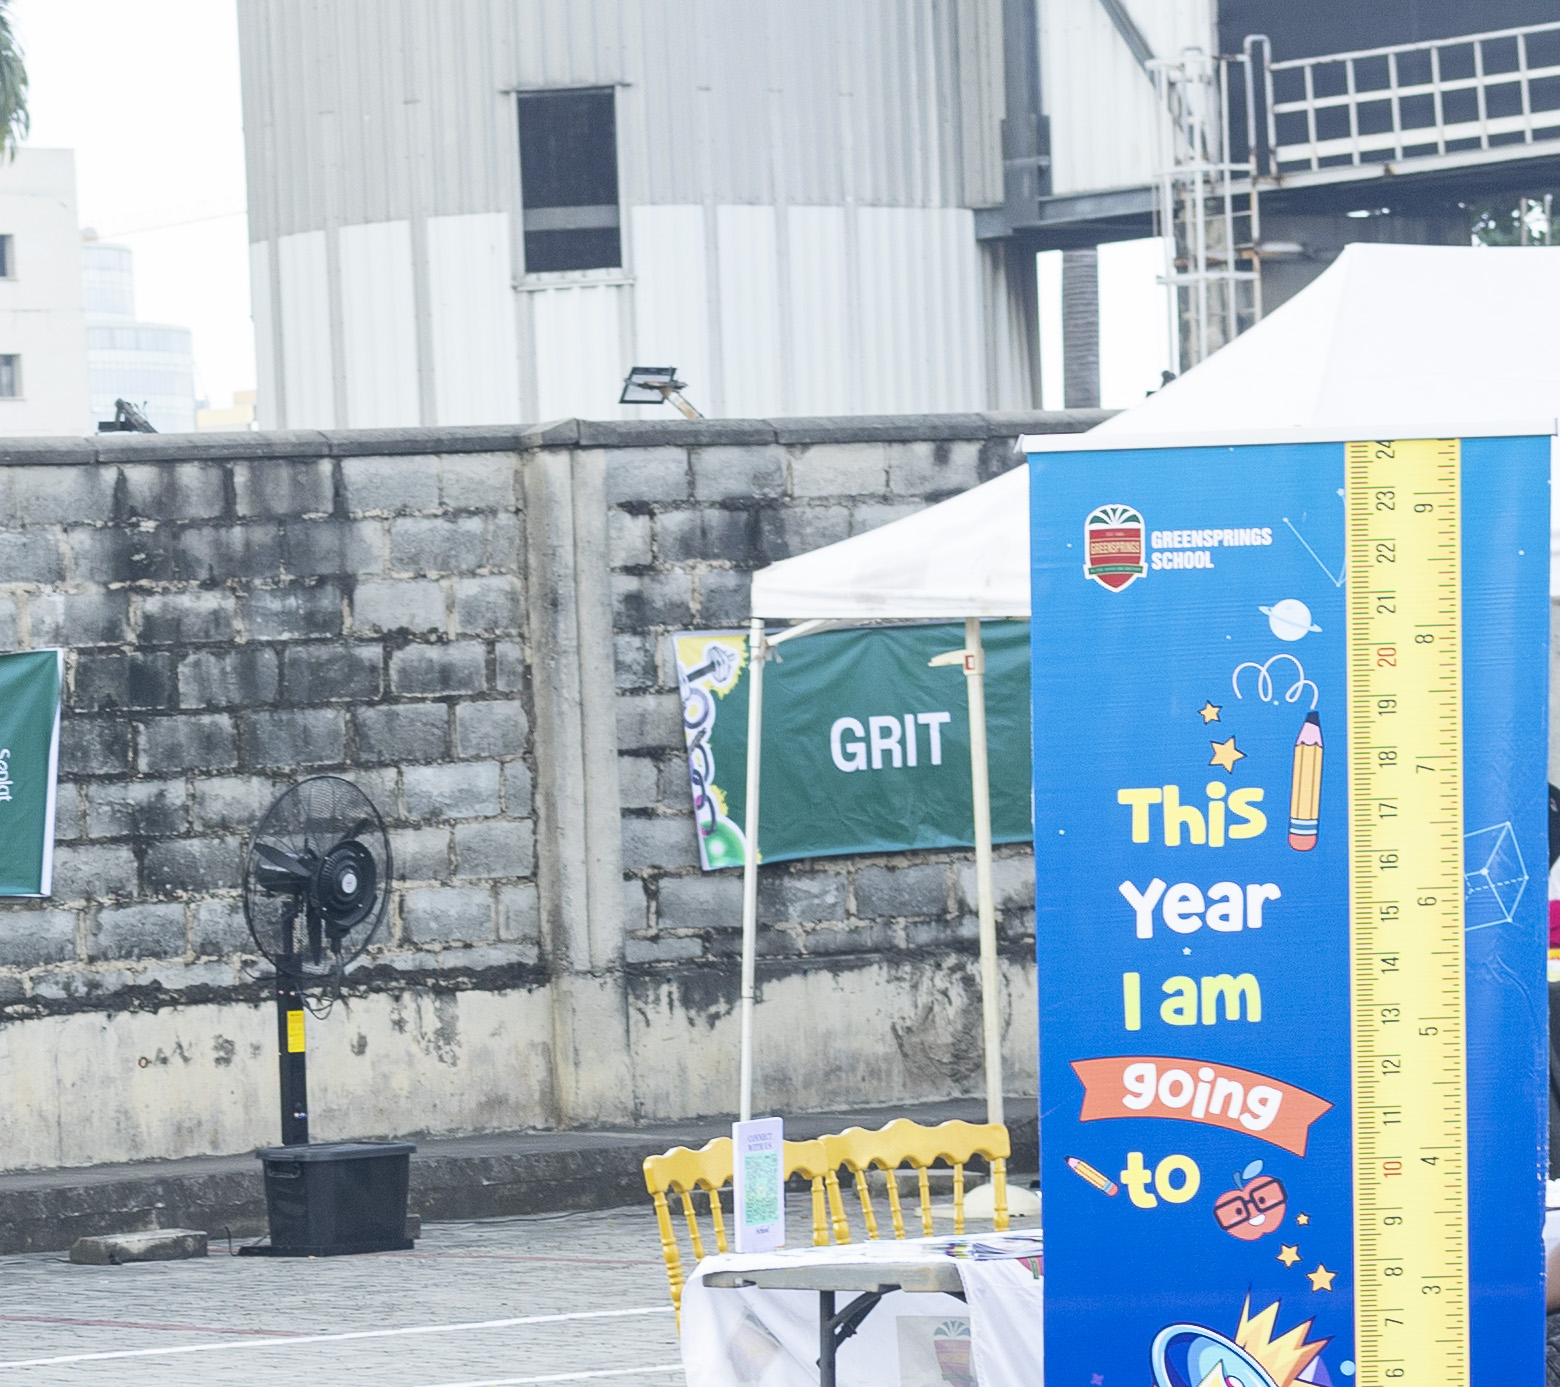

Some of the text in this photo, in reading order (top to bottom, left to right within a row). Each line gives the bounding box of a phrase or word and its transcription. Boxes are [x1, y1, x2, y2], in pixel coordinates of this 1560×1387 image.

[1376, 491, 1396, 511] 23
[1414, 503, 1434, 513] 9
[1151, 527, 1272, 549] GREENSPRINGS
[1151, 551, 1214, 570] SCHOOL
[1376, 543, 1396, 563] 22
[1377, 595, 1396, 614] 21
[1415, 633, 1435, 644] 8
[1377, 647, 1397, 667] 20
[1378, 699, 1397, 717] 19
[830, 711, 952, 773] GRIT
[1378, 751, 1397, 768] 18
[1415, 764, 1435, 774] 7
[1117, 781, 1268, 848] This
[1378, 803, 1398, 819] 17
[1379, 853, 1398, 871] 16
[1118, 877, 1281, 939] Year
[1417, 896, 1437, 906] 6
[1380, 905, 1399, 922] 15
[1381, 957, 1399, 974] 14
[1123, 972, 1261, 1031] I am
[1381, 1008, 1400, 1025] 13
[1418, 1026, 1438, 1036] 5
[1381, 1059, 1401, 1075] 12
[1121, 1062, 1283, 1131] going
[1382, 1111, 1401, 1126] 11
[1383, 1161, 1402, 1178] 10
[1420, 1156, 1439, 1166] 4
[1120, 1151, 1201, 1209] to
[1383, 1216, 1403, 1226] 9
[1384, 1266, 1403, 1277] 8
[1422, 1285, 1441, 1295] 3
[1384, 1316, 1404, 1326] 7
[1385, 1367, 1405, 1378] 6
